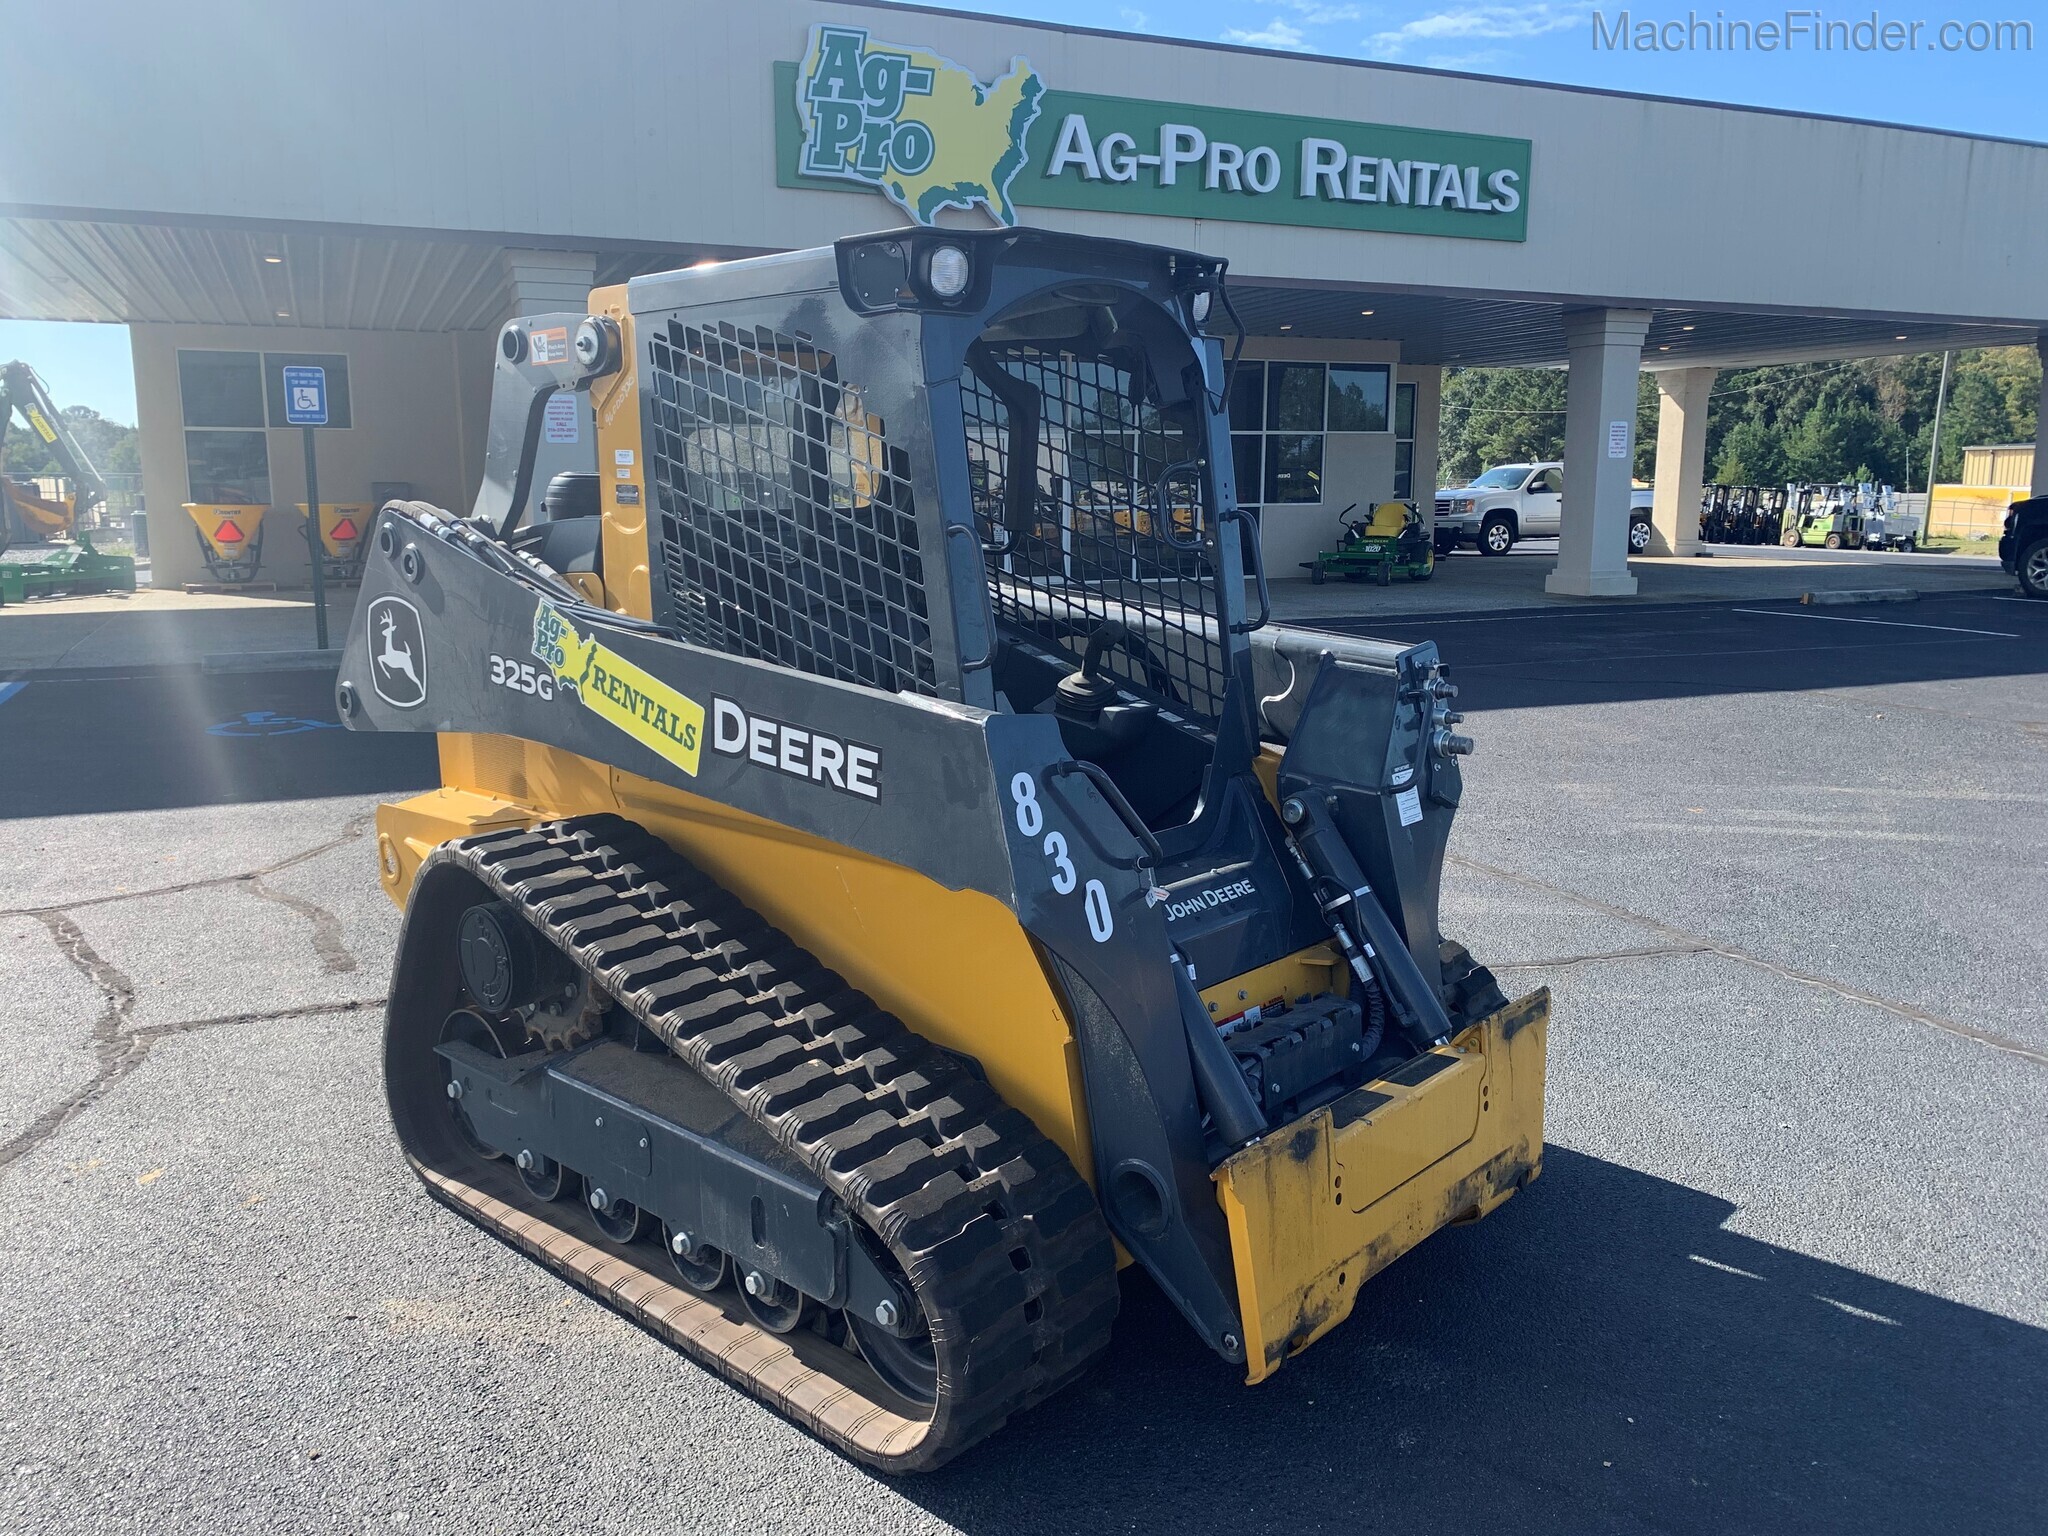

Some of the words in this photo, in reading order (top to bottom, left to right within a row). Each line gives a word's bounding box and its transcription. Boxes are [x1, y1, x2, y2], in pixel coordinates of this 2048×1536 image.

[804, 27, 935, 120] Ag-
[806, 99, 935, 176] Pro
[533, 628, 567, 668] Pro
[536, 603, 568, 644] Ag-
[490, 654, 553, 701] 325G
[591, 664, 697, 752] RENTALS
[713, 697, 879, 798] DEERE
[1164, 896, 1208, 922] JOHN
[1201, 879, 1256, 907] DEERE
